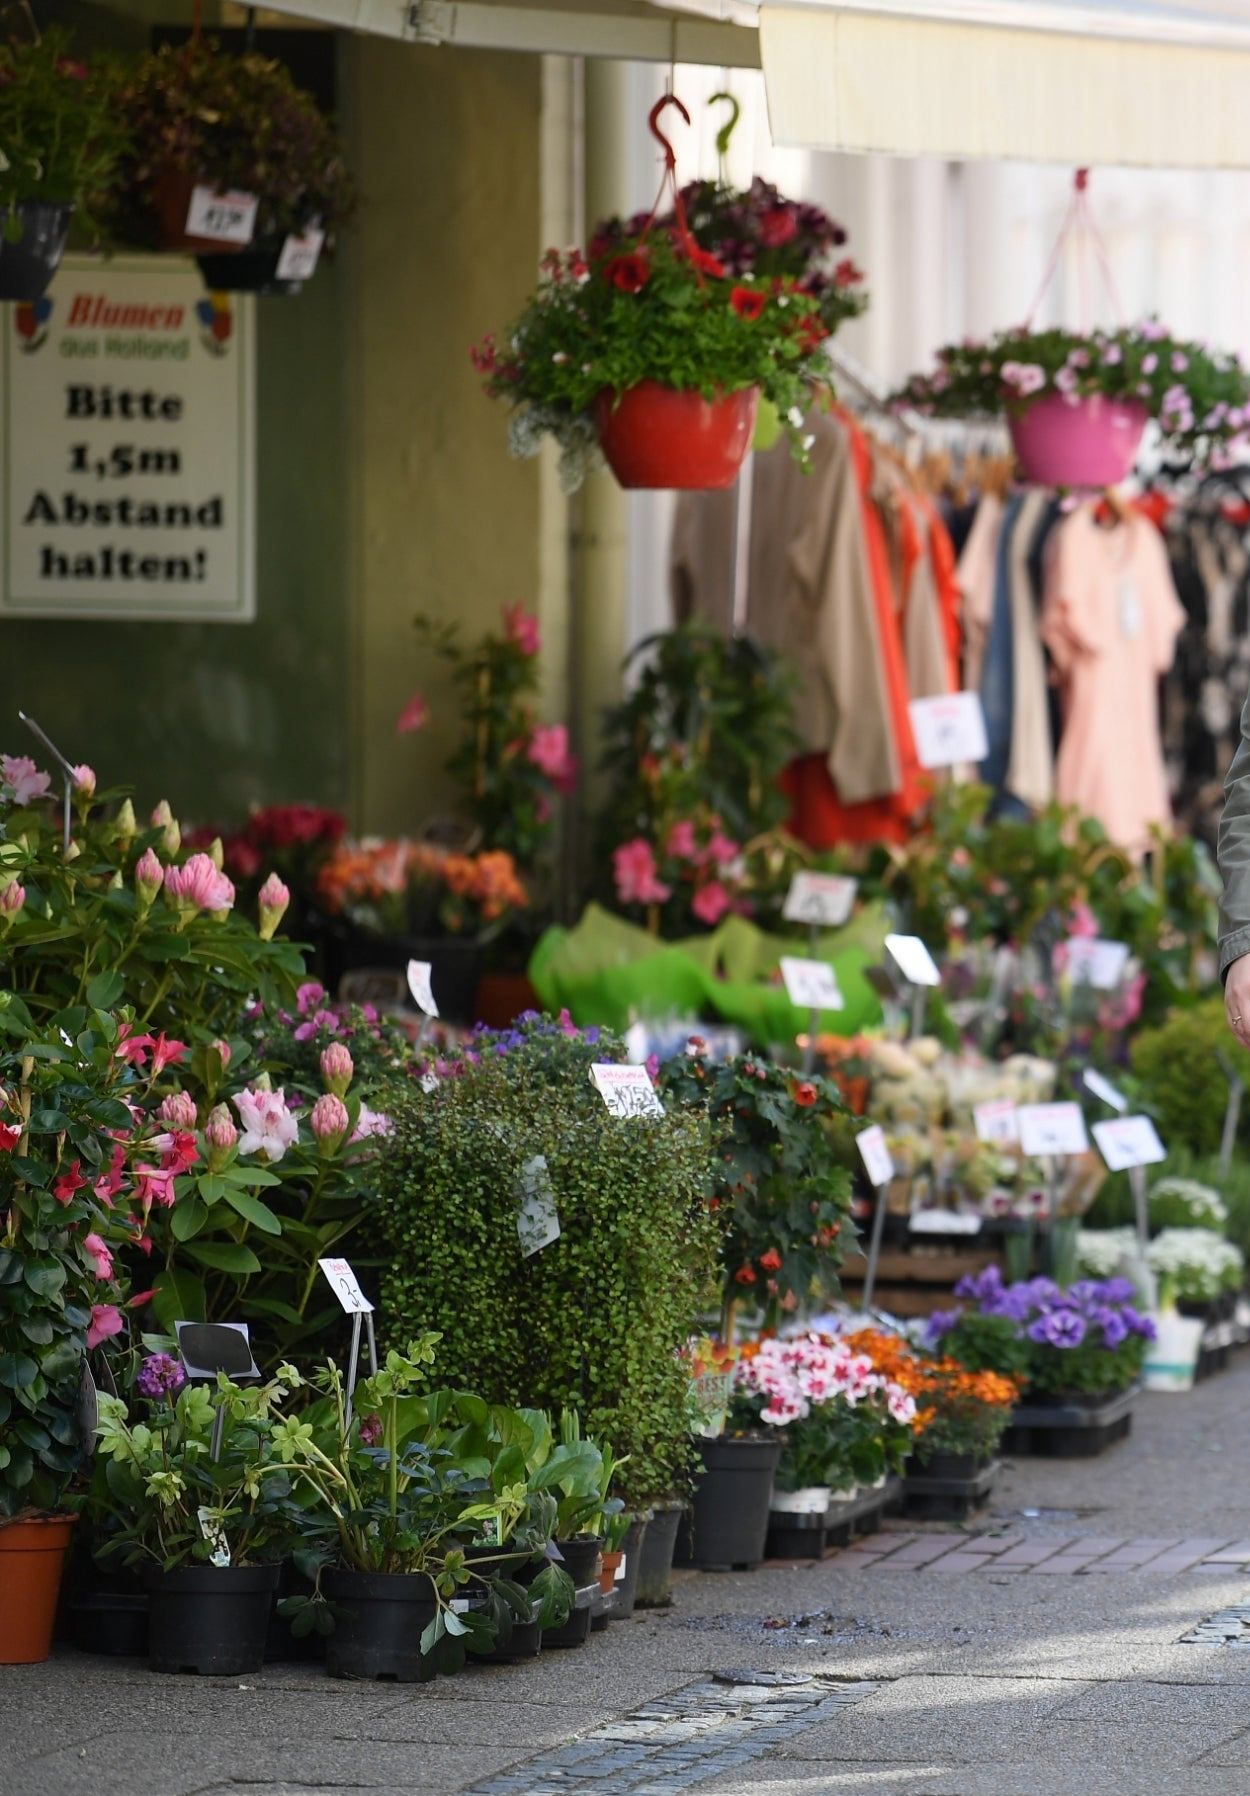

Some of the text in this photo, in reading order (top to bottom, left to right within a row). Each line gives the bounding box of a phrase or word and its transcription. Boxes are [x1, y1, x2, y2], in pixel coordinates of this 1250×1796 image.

[67, 293, 185, 331] Blumen
[104, 335, 190, 361] Holland
[66, 384, 182, 420] Bitte
[69, 442, 181, 481] 1,5m
[24, 490, 223, 528] Abstand
[41, 544, 206, 582] halten!
